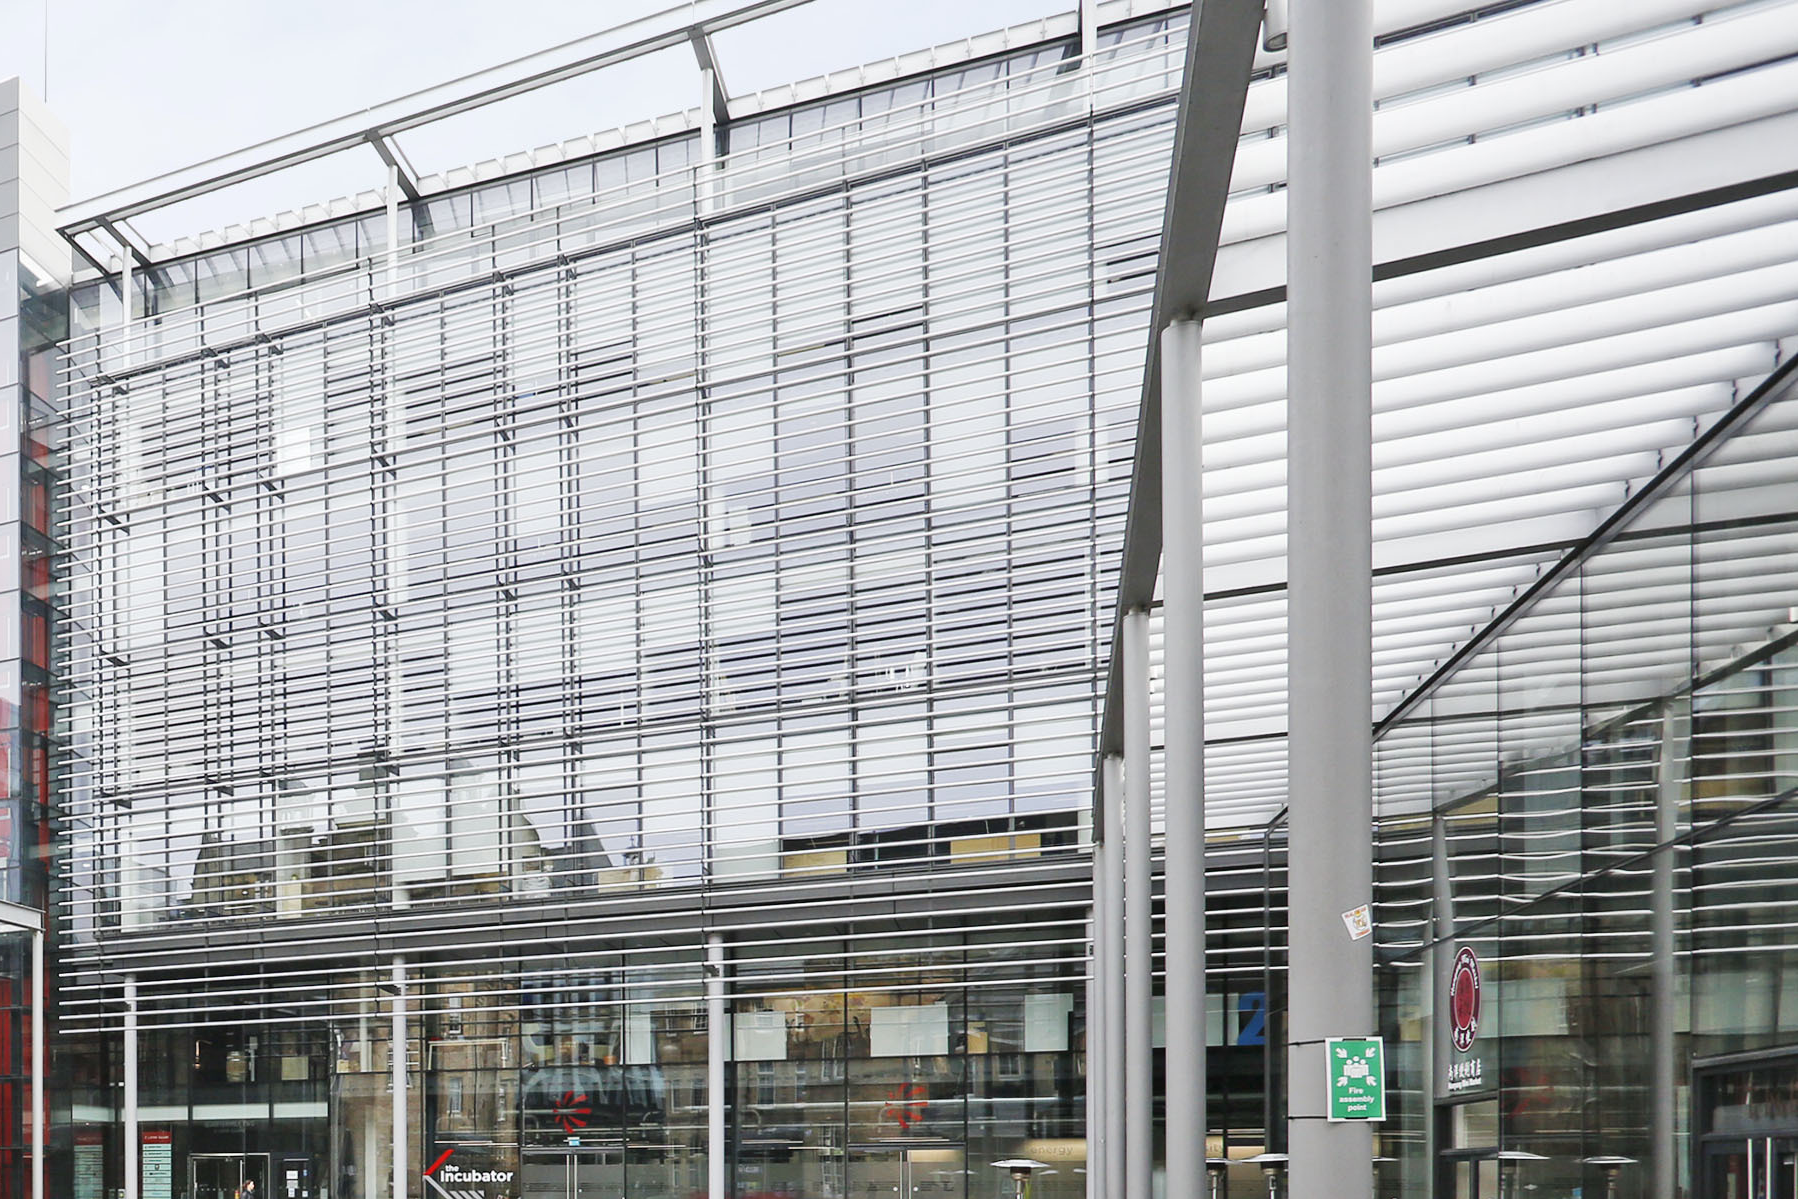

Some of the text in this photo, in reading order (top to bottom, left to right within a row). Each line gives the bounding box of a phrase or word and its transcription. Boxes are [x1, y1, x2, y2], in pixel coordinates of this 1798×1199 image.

[1237, 992, 1266, 1046] 2
[1339, 1096, 1375, 1104] assembly
[1347, 1104, 1367, 1112] point
[445, 1164, 459, 1172] the
[440, 1169, 514, 1183] Incubator
